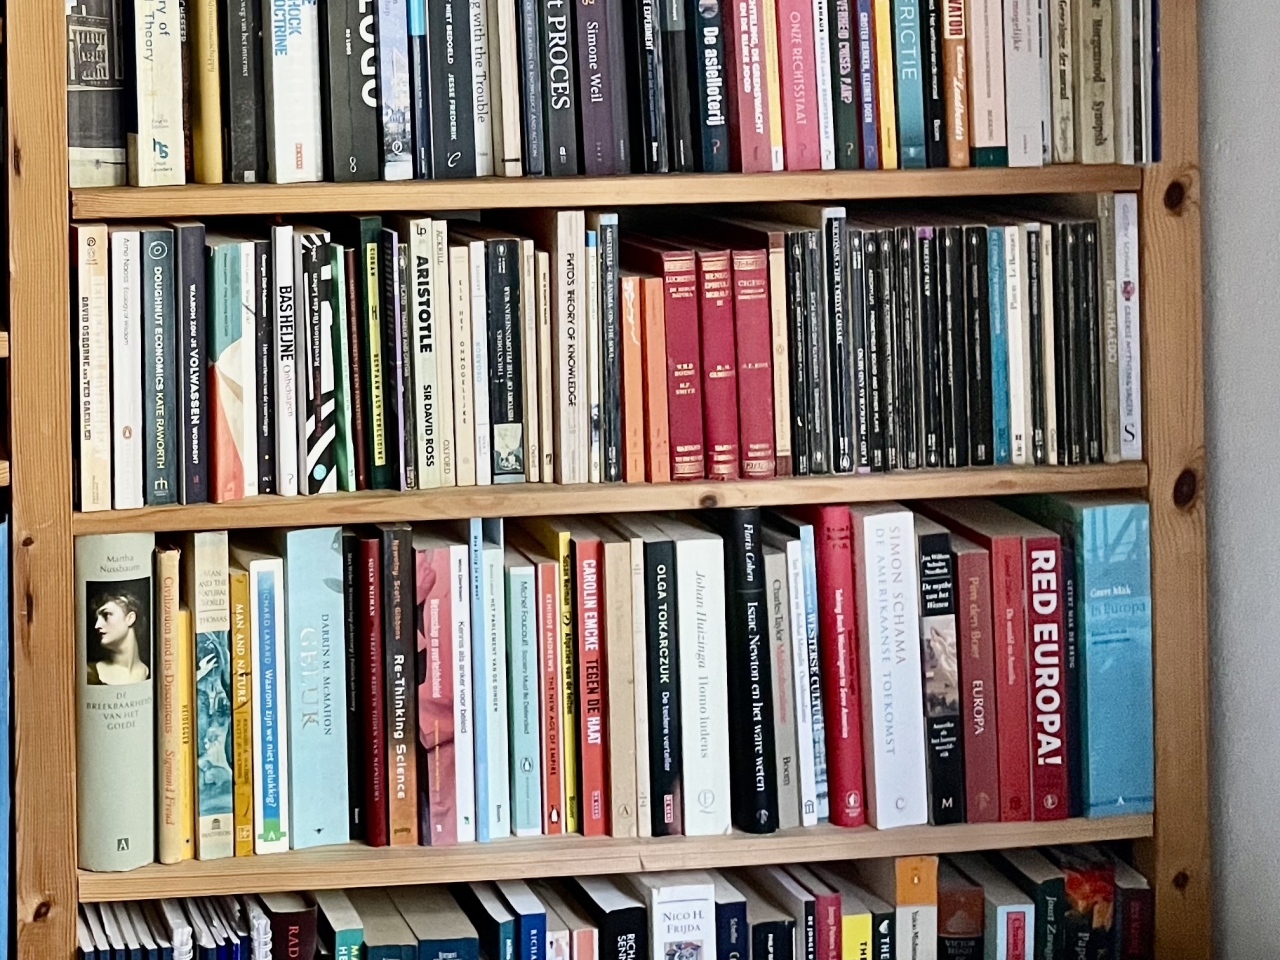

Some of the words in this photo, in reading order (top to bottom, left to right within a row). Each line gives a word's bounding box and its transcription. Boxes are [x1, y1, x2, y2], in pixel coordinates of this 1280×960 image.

[586, 21, 599, 70] Simone
[703, 27, 719, 46] De
[789, 11, 801, 44] ONZE
[547, 16, 570, 109] PROCES
[589, 73, 602, 102] Weil
[704, 49, 724, 126] asielloterij
[791, 48, 806, 125] RECHTSSTAAT
[153, 266, 162, 325] DOUGHNUT
[279, 286, 292, 312] BAS
[416, 256, 432, 353] ARISTOTLE
[280, 316, 293, 361] HEIJNE
[154, 328, 163, 390] ECONOMICS
[155, 392, 163, 416] KATE
[189, 349, 199, 424] VOLWASSEN
[424, 384, 433, 401] SIR
[424, 403, 434, 437] DAVID
[156, 419, 165, 469] RAWORTH
[425, 439, 435, 468] ROSS
[583, 559, 596, 608] CAROLIN
[656, 564, 667, 599] OLGA
[1031, 550, 1057, 615] RED
[235, 604, 244, 628] MAN
[584, 612, 598, 651] EMCKE
[747, 602, 759, 631] Isaac
[236, 634, 245, 655] AND
[657, 603, 670, 683] TOKARCZUK
[749, 635, 761, 681] Newton
[236, 660, 245, 702] NATURE
[585, 659, 598, 695] TEGEN
[751, 684, 760, 699] en
[1033, 623, 1062, 765] EUROPA!
[587, 699, 599, 713] DE
[752, 703, 763, 721] het
[972, 680, 984, 734] EUROPA
[587, 716, 600, 744] HAAT
[754, 725, 764, 753] ware
[755, 757, 765, 791] weten
